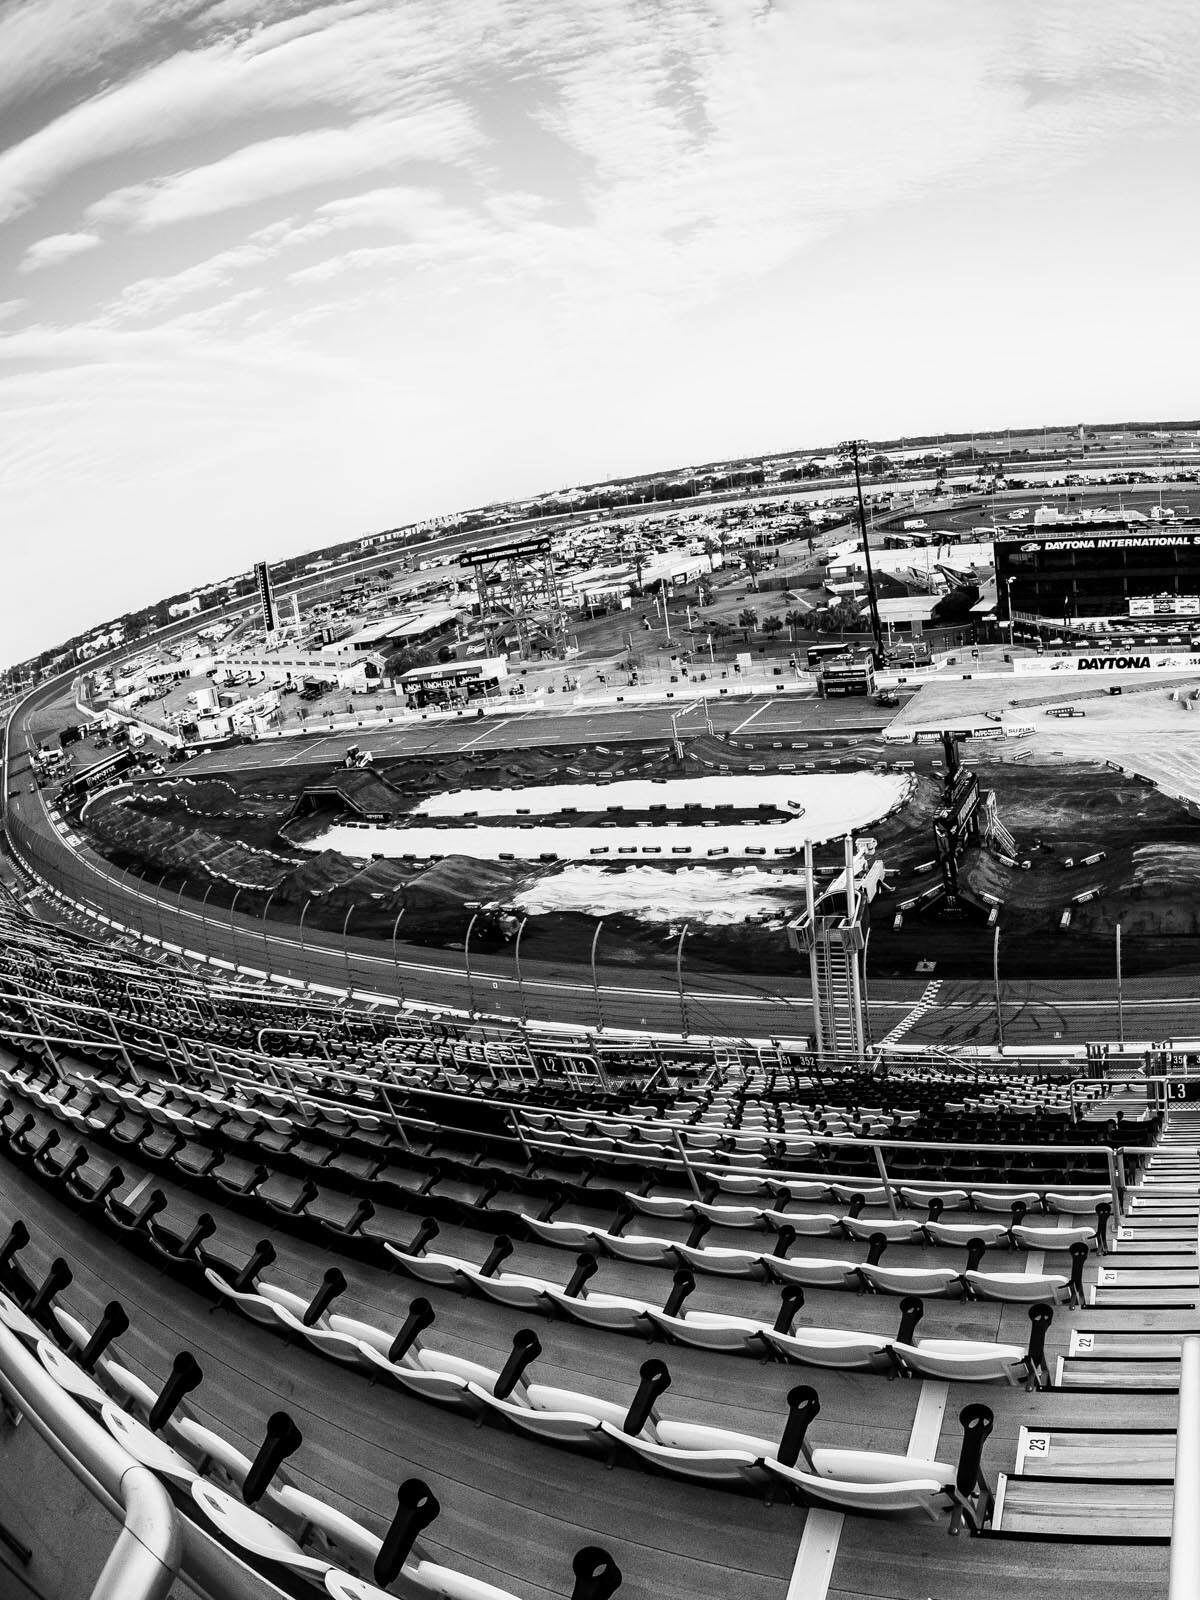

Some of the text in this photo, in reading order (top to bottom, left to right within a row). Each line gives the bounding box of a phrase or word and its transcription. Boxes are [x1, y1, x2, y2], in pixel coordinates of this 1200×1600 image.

[1045, 540, 1095, 550] DAYTONA
[1098, 538, 1191, 548] INTERNATIONAL
[1077, 656, 1151, 670] DAYTONA
[542, 1057, 558, 1072] L2
[800, 1056, 815, 1066] 352
[1173, 1055, 1183, 1064] 35
[1078, 1338, 1092, 1348] 22
[1029, 1439, 1046, 1451] 23
